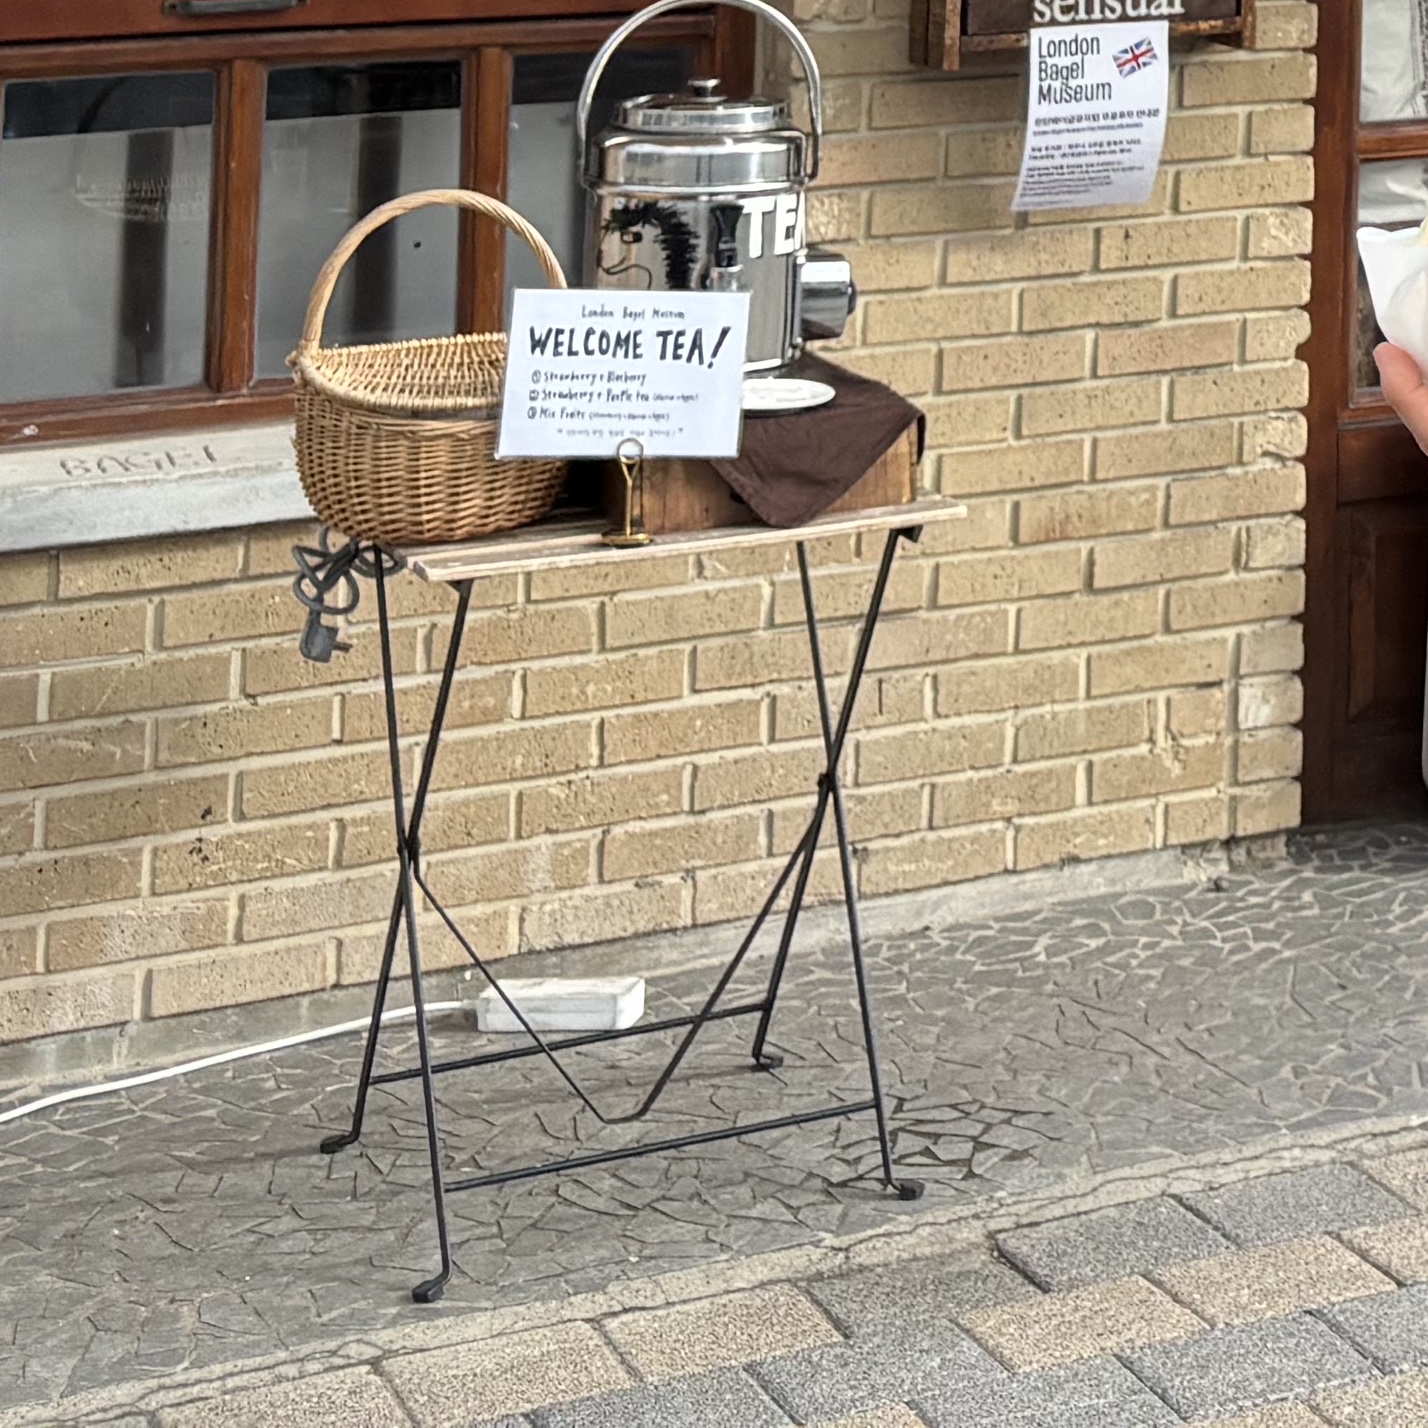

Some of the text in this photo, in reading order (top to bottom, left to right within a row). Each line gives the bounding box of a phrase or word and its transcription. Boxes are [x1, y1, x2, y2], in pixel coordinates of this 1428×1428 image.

[1038, 34, 1100, 58] London
[1038, 55, 1084, 87] Bagel
[1038, 82, 1112, 105] Museum
[582, 304, 614, 319] London
[622, 305, 646, 322] Bagel
[529, 325, 732, 369] WELCOME TEA!
[544, 371, 597, 387] Strawberry
